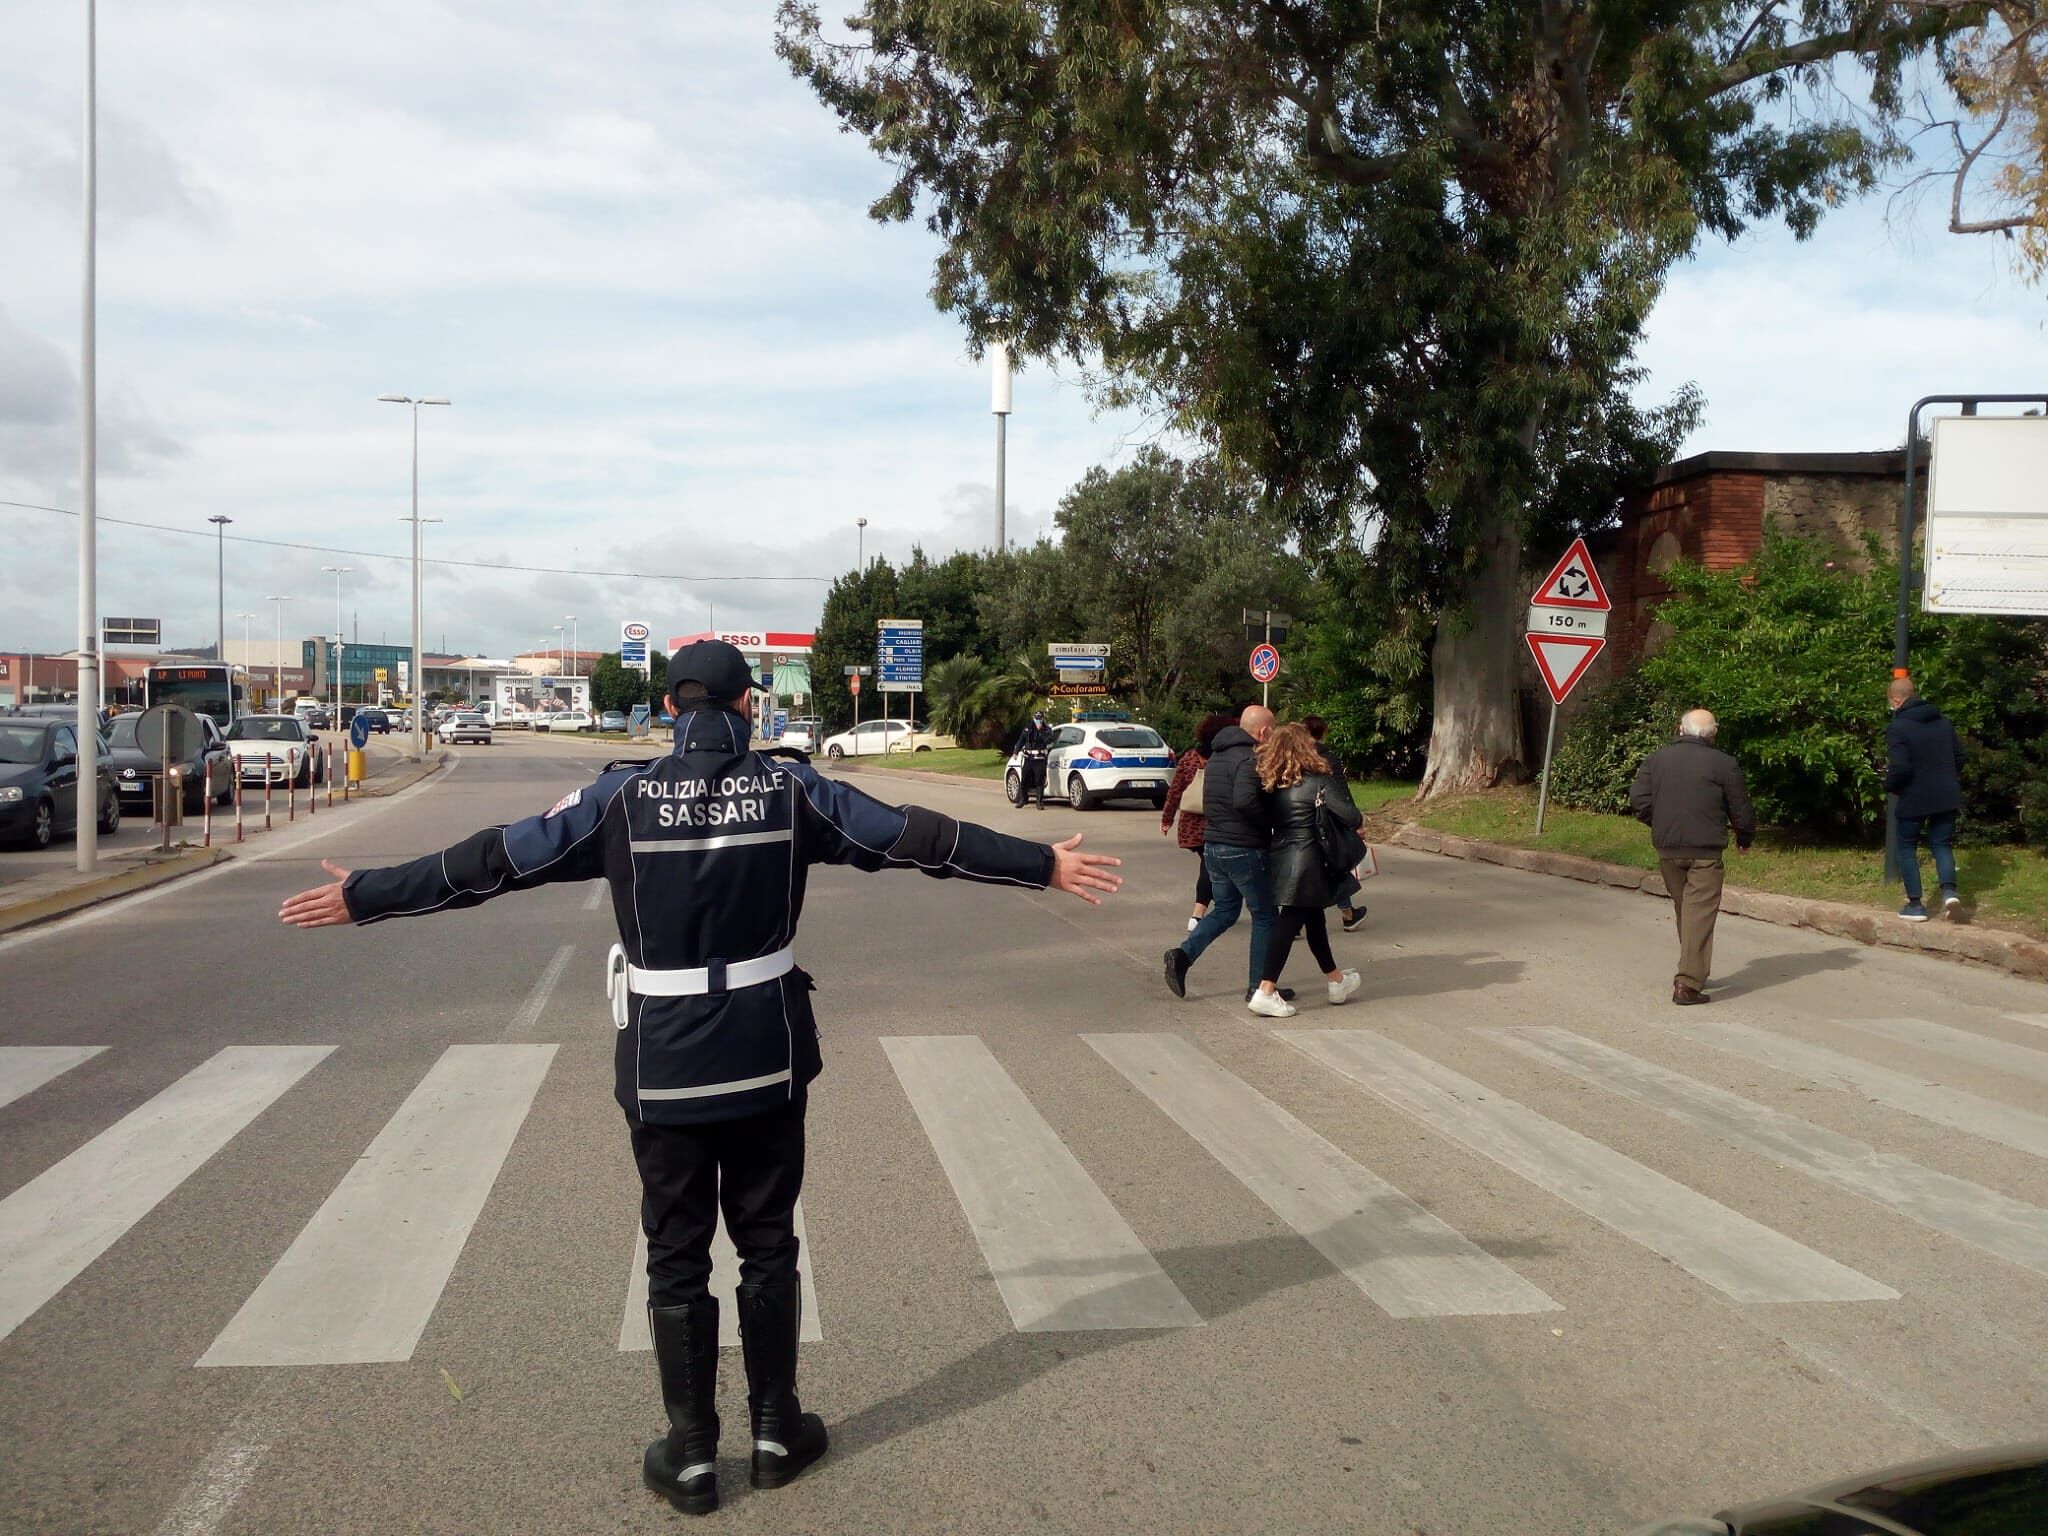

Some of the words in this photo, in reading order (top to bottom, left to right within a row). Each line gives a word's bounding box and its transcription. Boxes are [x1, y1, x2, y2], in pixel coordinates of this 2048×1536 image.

[1549, 615, 1574, 627] 150
[628, 627, 645, 635] Esso
[721, 635, 760, 645] ESSO
[1060, 684, 1106, 693] Conforama
[637, 779, 708, 799] POLIZIA
[711, 771, 785, 797] LOCALE
[658, 799, 766, 827] SASSARI
